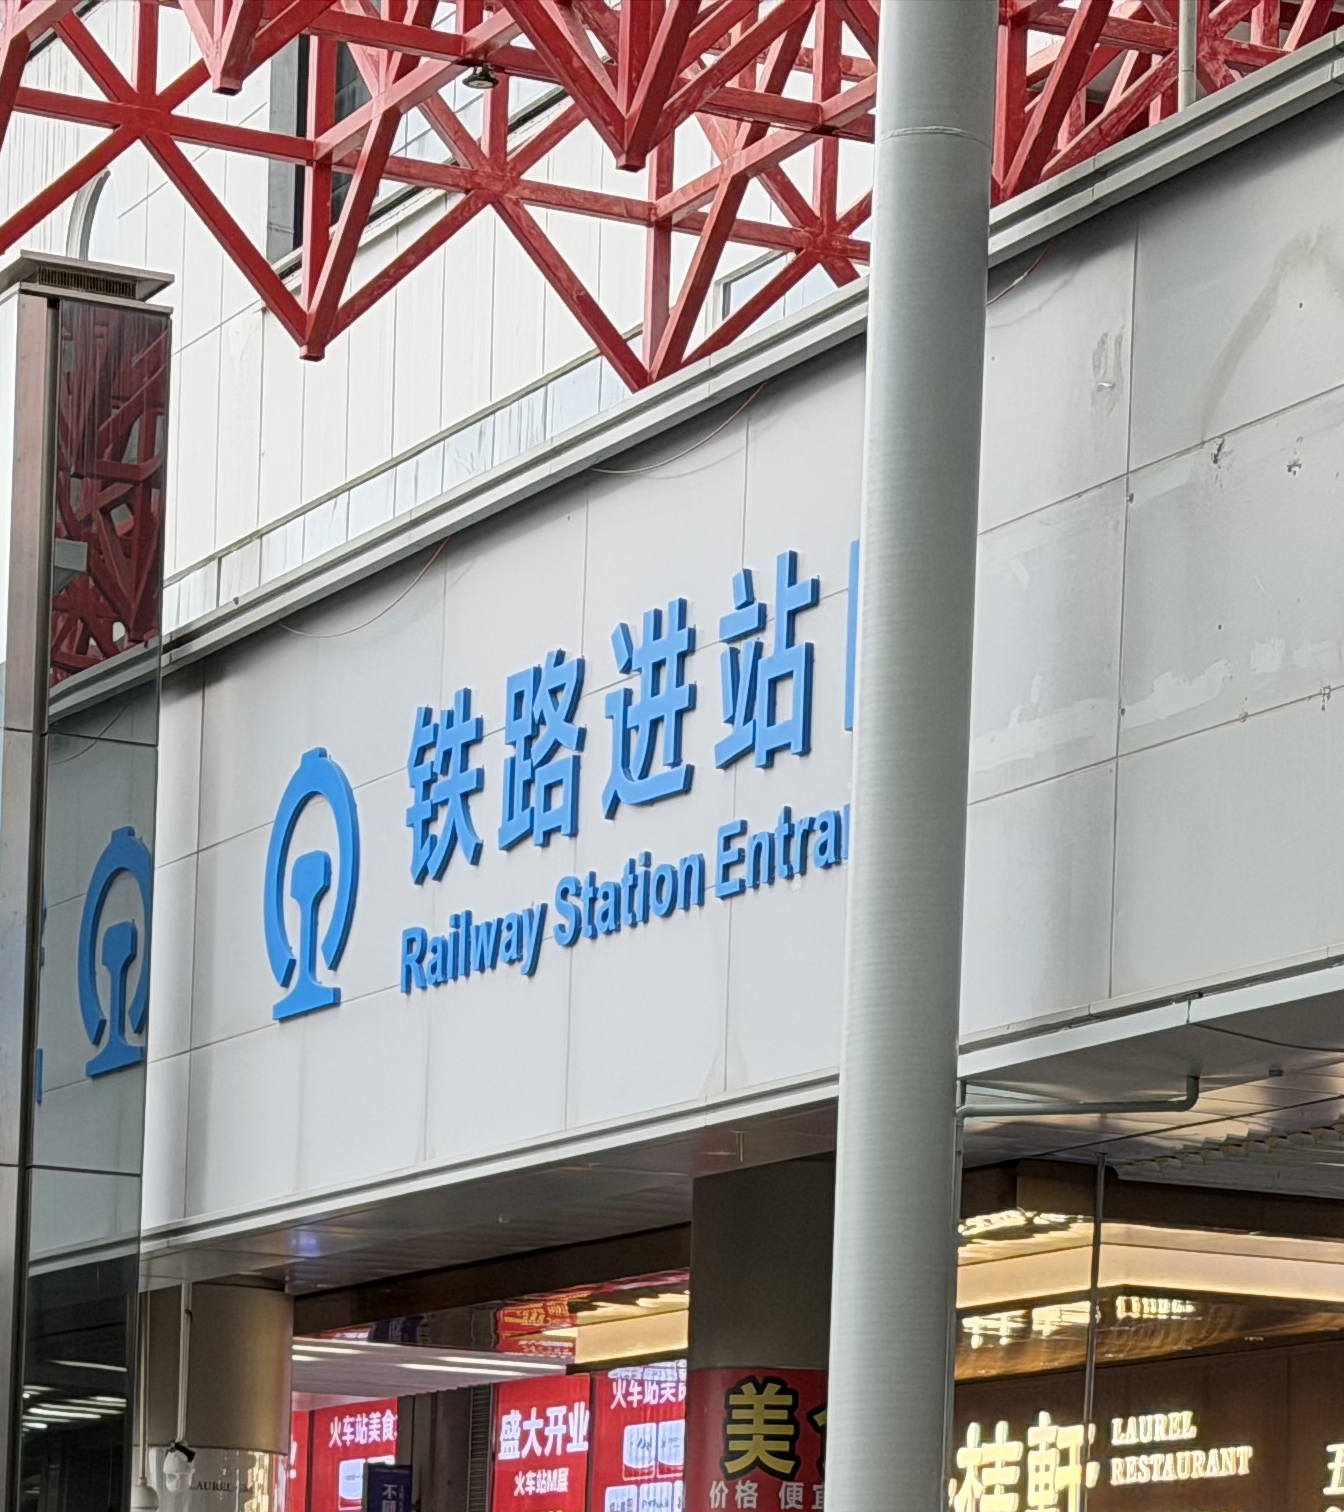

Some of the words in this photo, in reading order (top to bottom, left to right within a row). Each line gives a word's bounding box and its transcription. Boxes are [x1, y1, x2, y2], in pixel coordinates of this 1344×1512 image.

[406, 539, 860, 885] 铁路进站
[401, 902, 548, 993] Railway
[554, 851, 706, 947] Station
[329, 1408, 398, 1448] 火车站美食
[498, 1401, 590, 1461] 盛大开业
[1111, 1411, 1197, 1445] LAUREL
[1110, 1446, 1253, 1486] RESTAURANT
[709, 1480, 759, 1510] 价格
